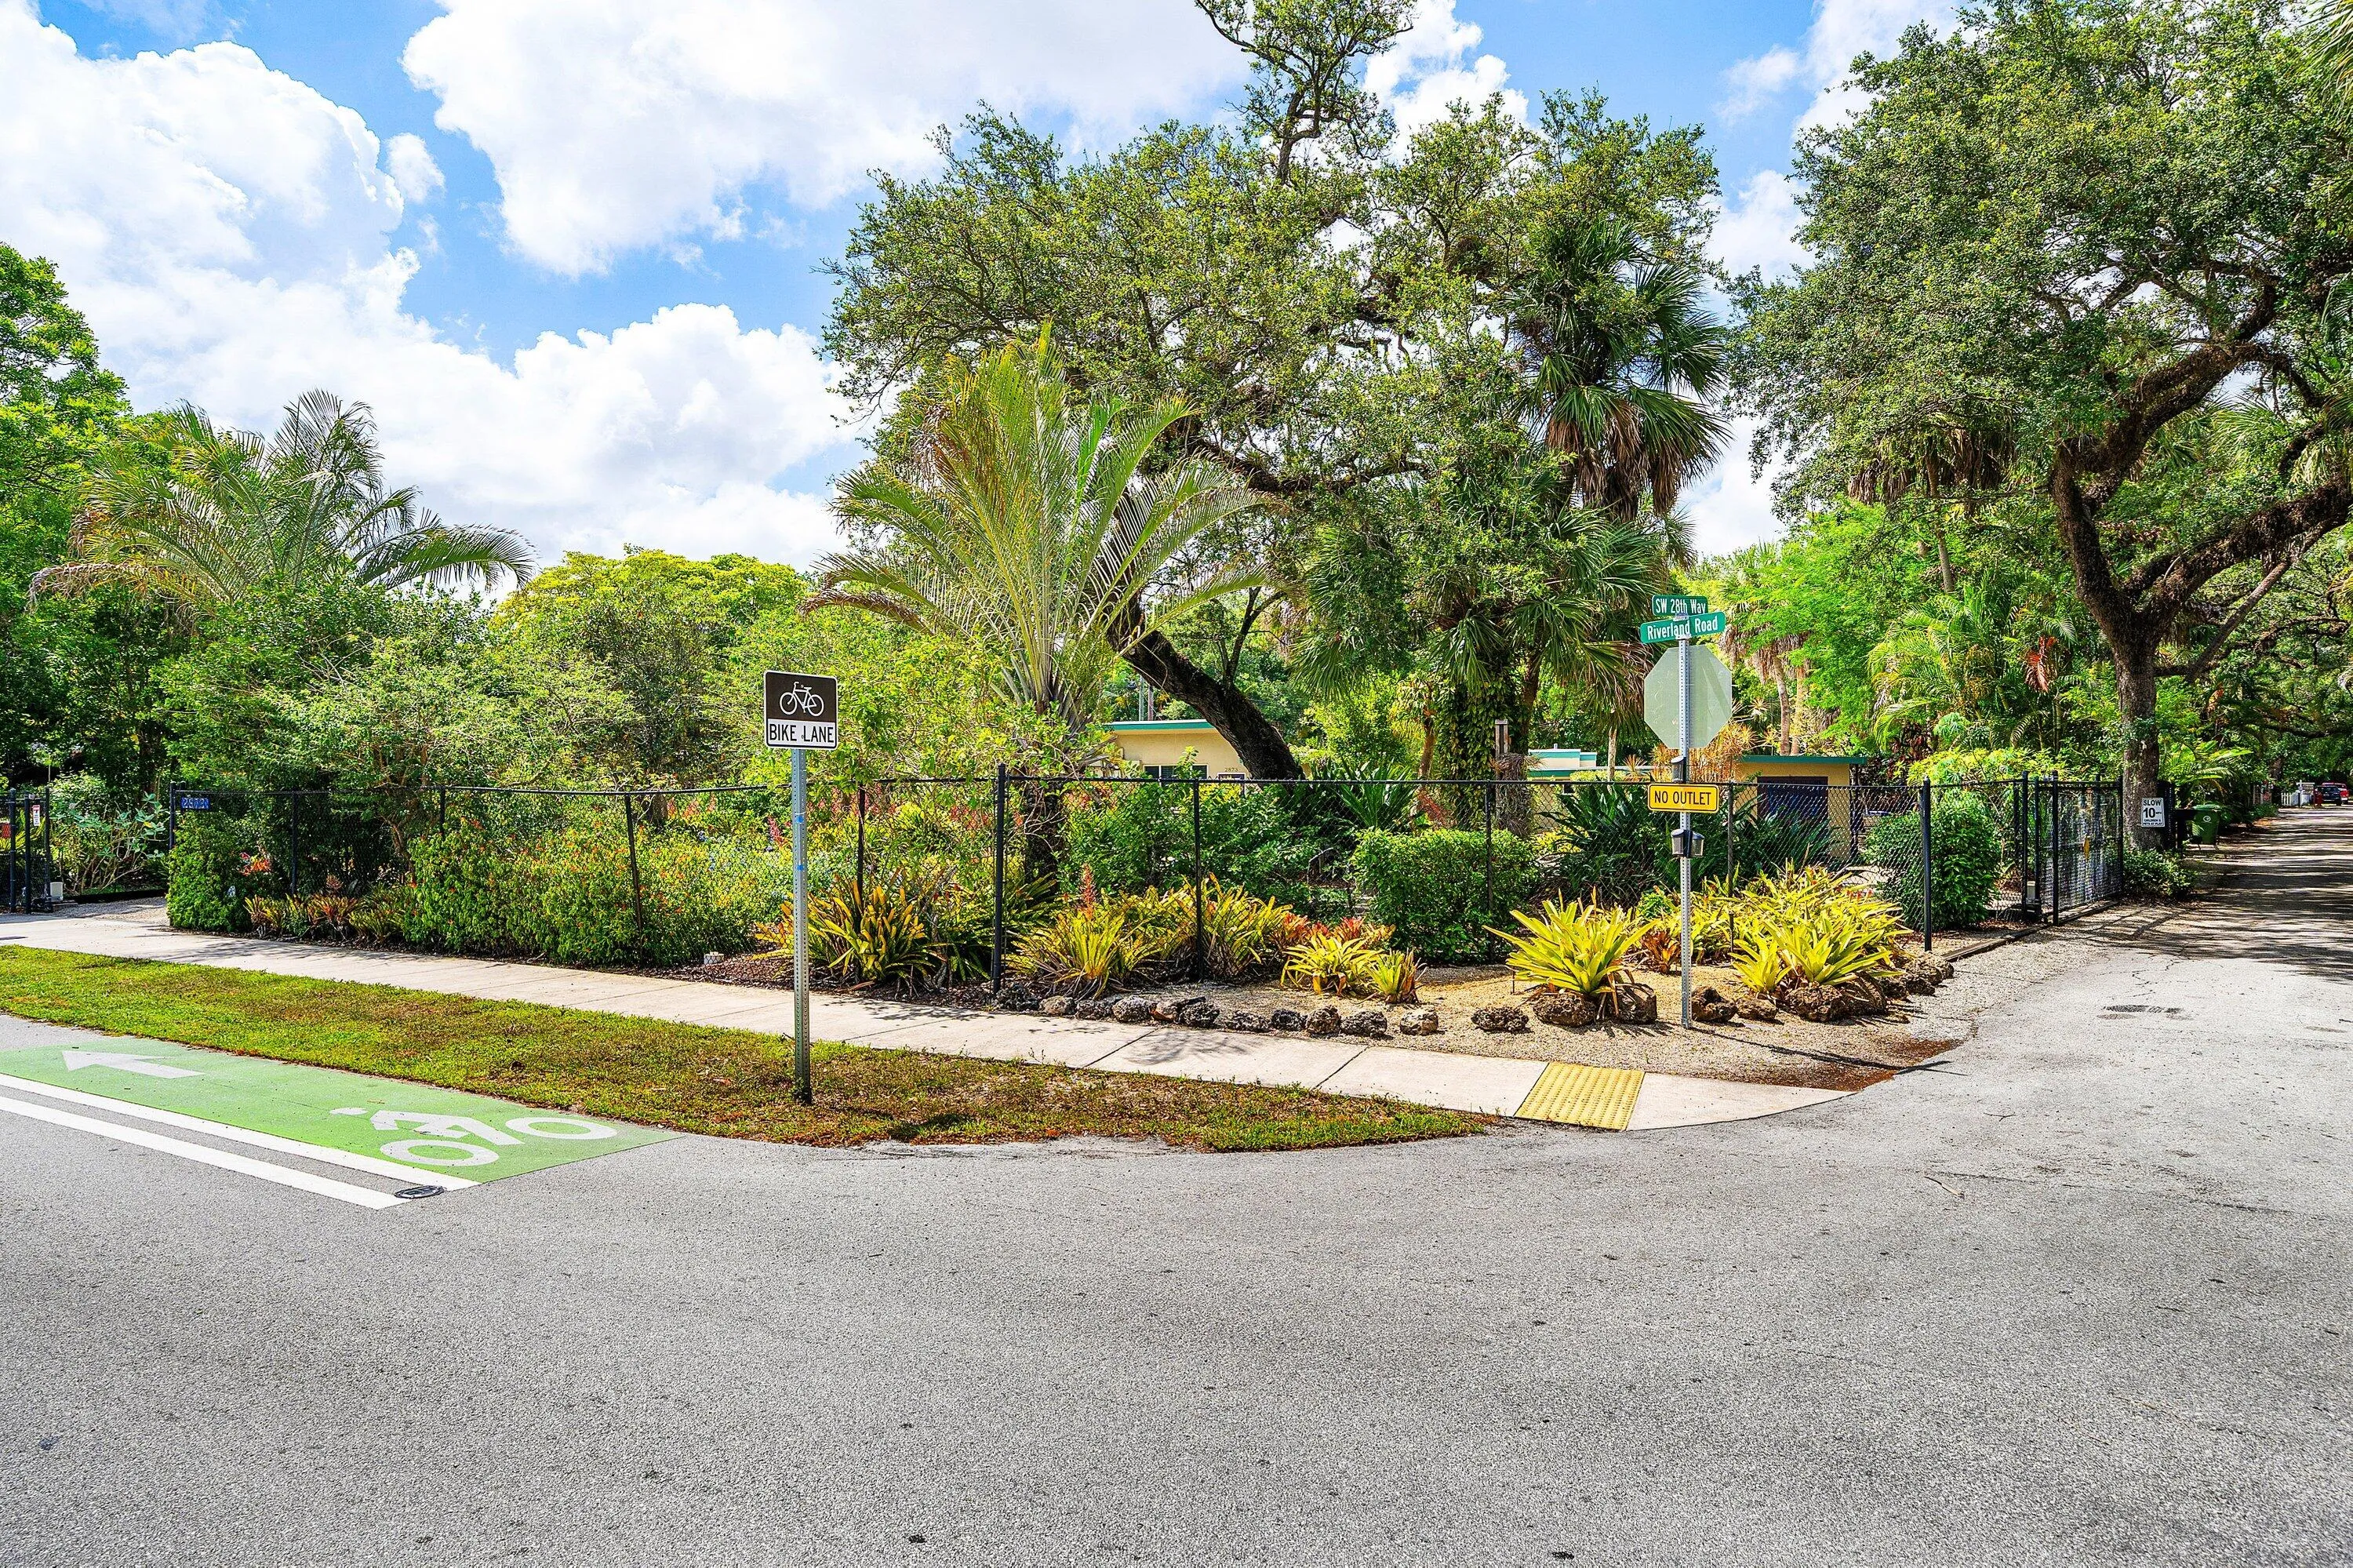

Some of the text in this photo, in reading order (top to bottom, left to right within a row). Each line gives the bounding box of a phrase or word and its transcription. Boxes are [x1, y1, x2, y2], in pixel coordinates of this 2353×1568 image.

[1655, 598, 1706, 614] SW 28th Way
[1647, 615, 1718, 640] Riverland Road
[769, 723, 835, 743] BIKE LANE
[1654, 791, 1711, 806] NO OUTLET
[2144, 808, 2155, 818] 10
